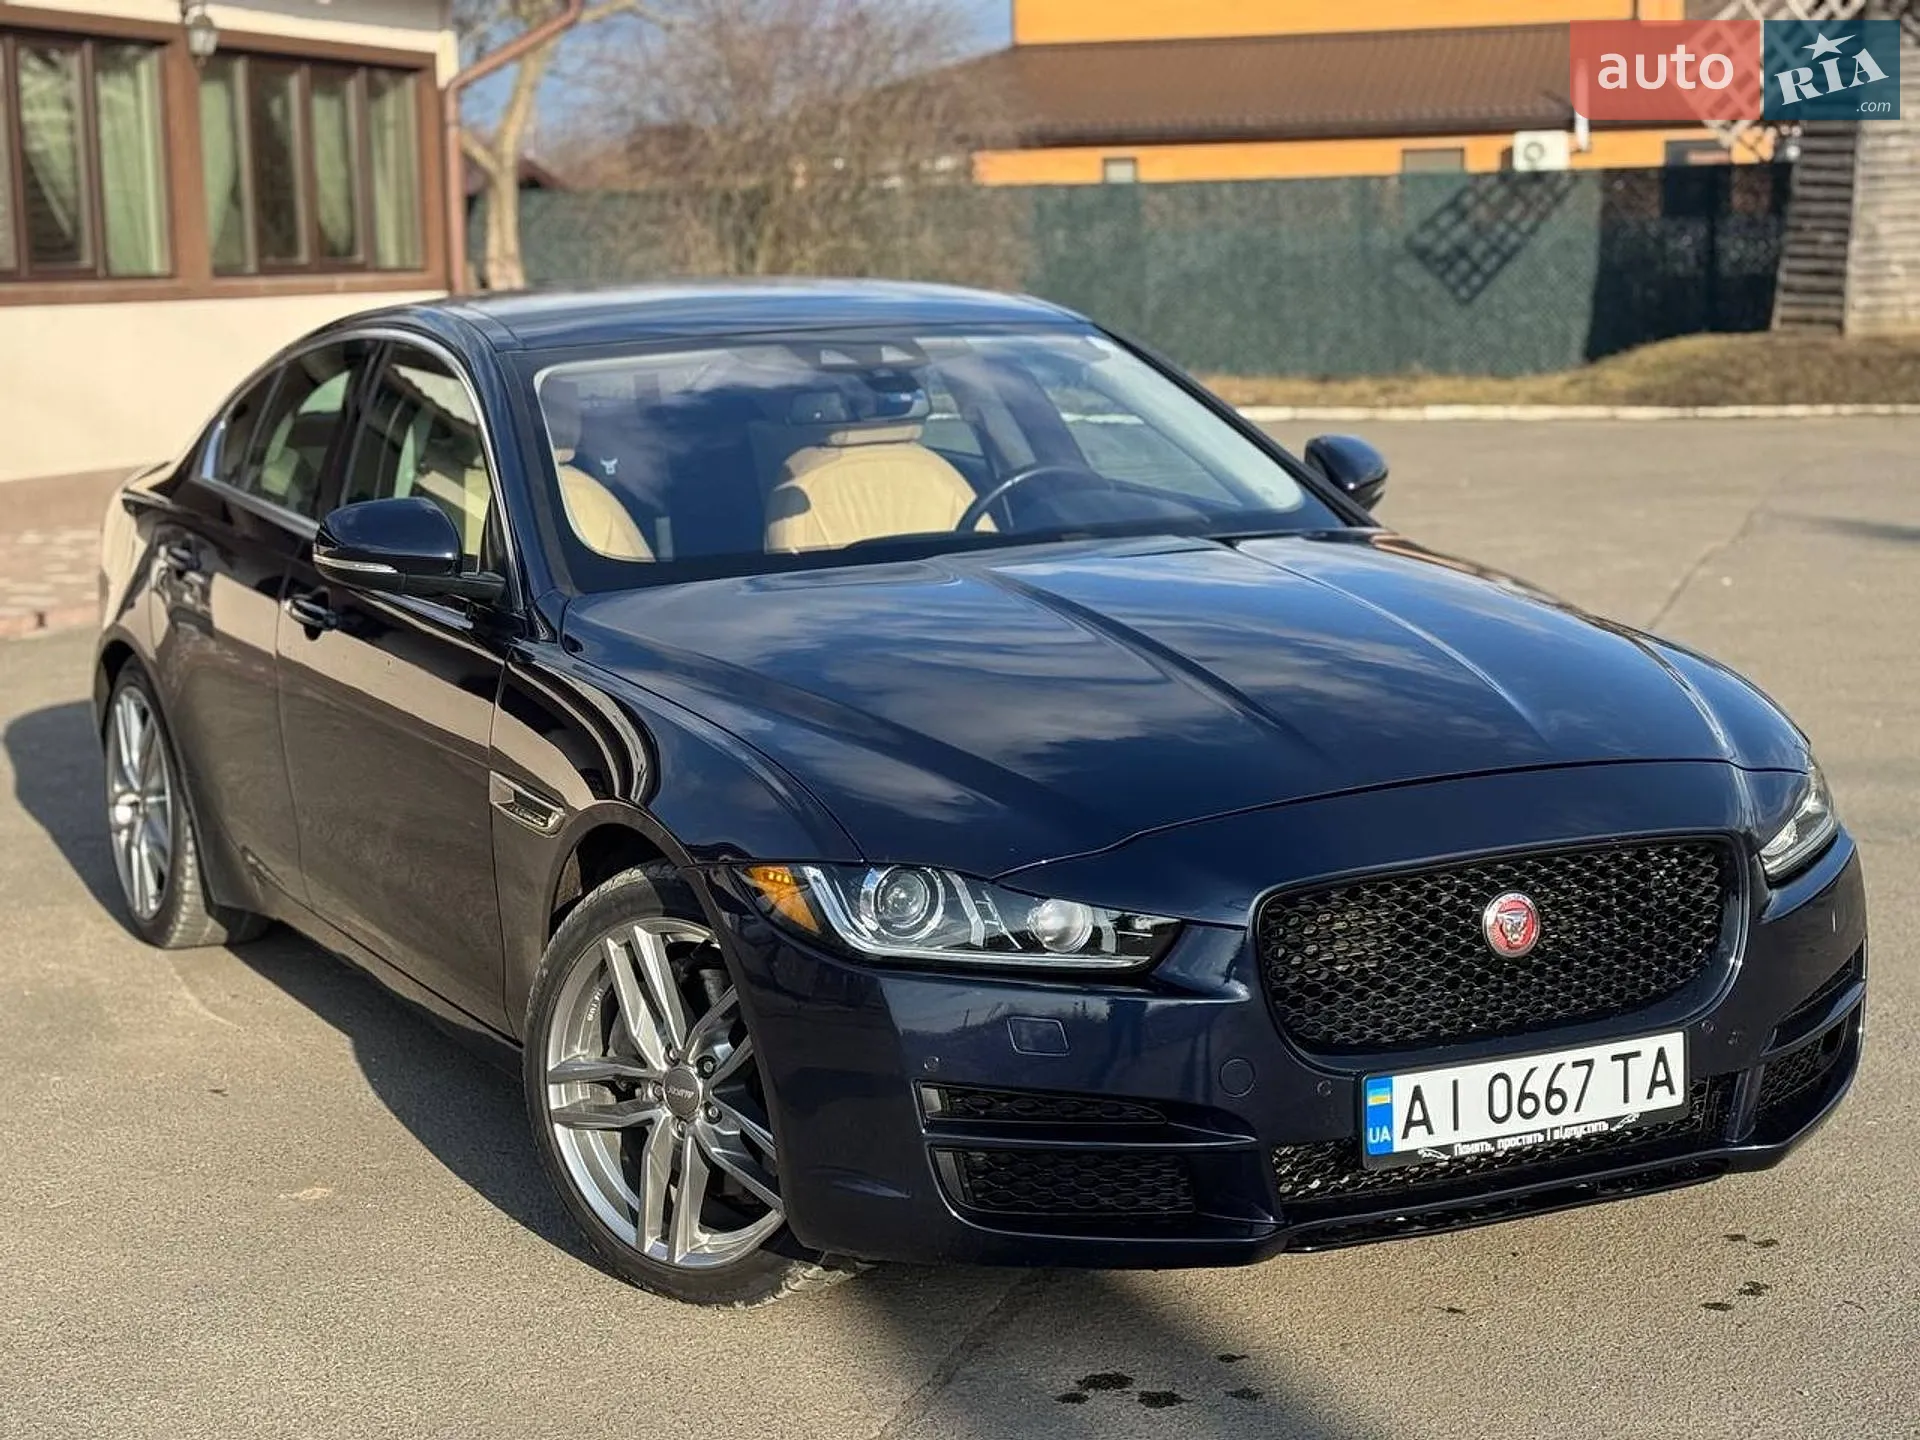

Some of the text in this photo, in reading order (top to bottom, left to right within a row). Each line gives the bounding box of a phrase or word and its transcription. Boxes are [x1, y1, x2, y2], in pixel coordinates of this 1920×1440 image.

[1401, 1046, 1676, 1140] AI 0667 TA
[1367, 1125, 1392, 1143] UA
